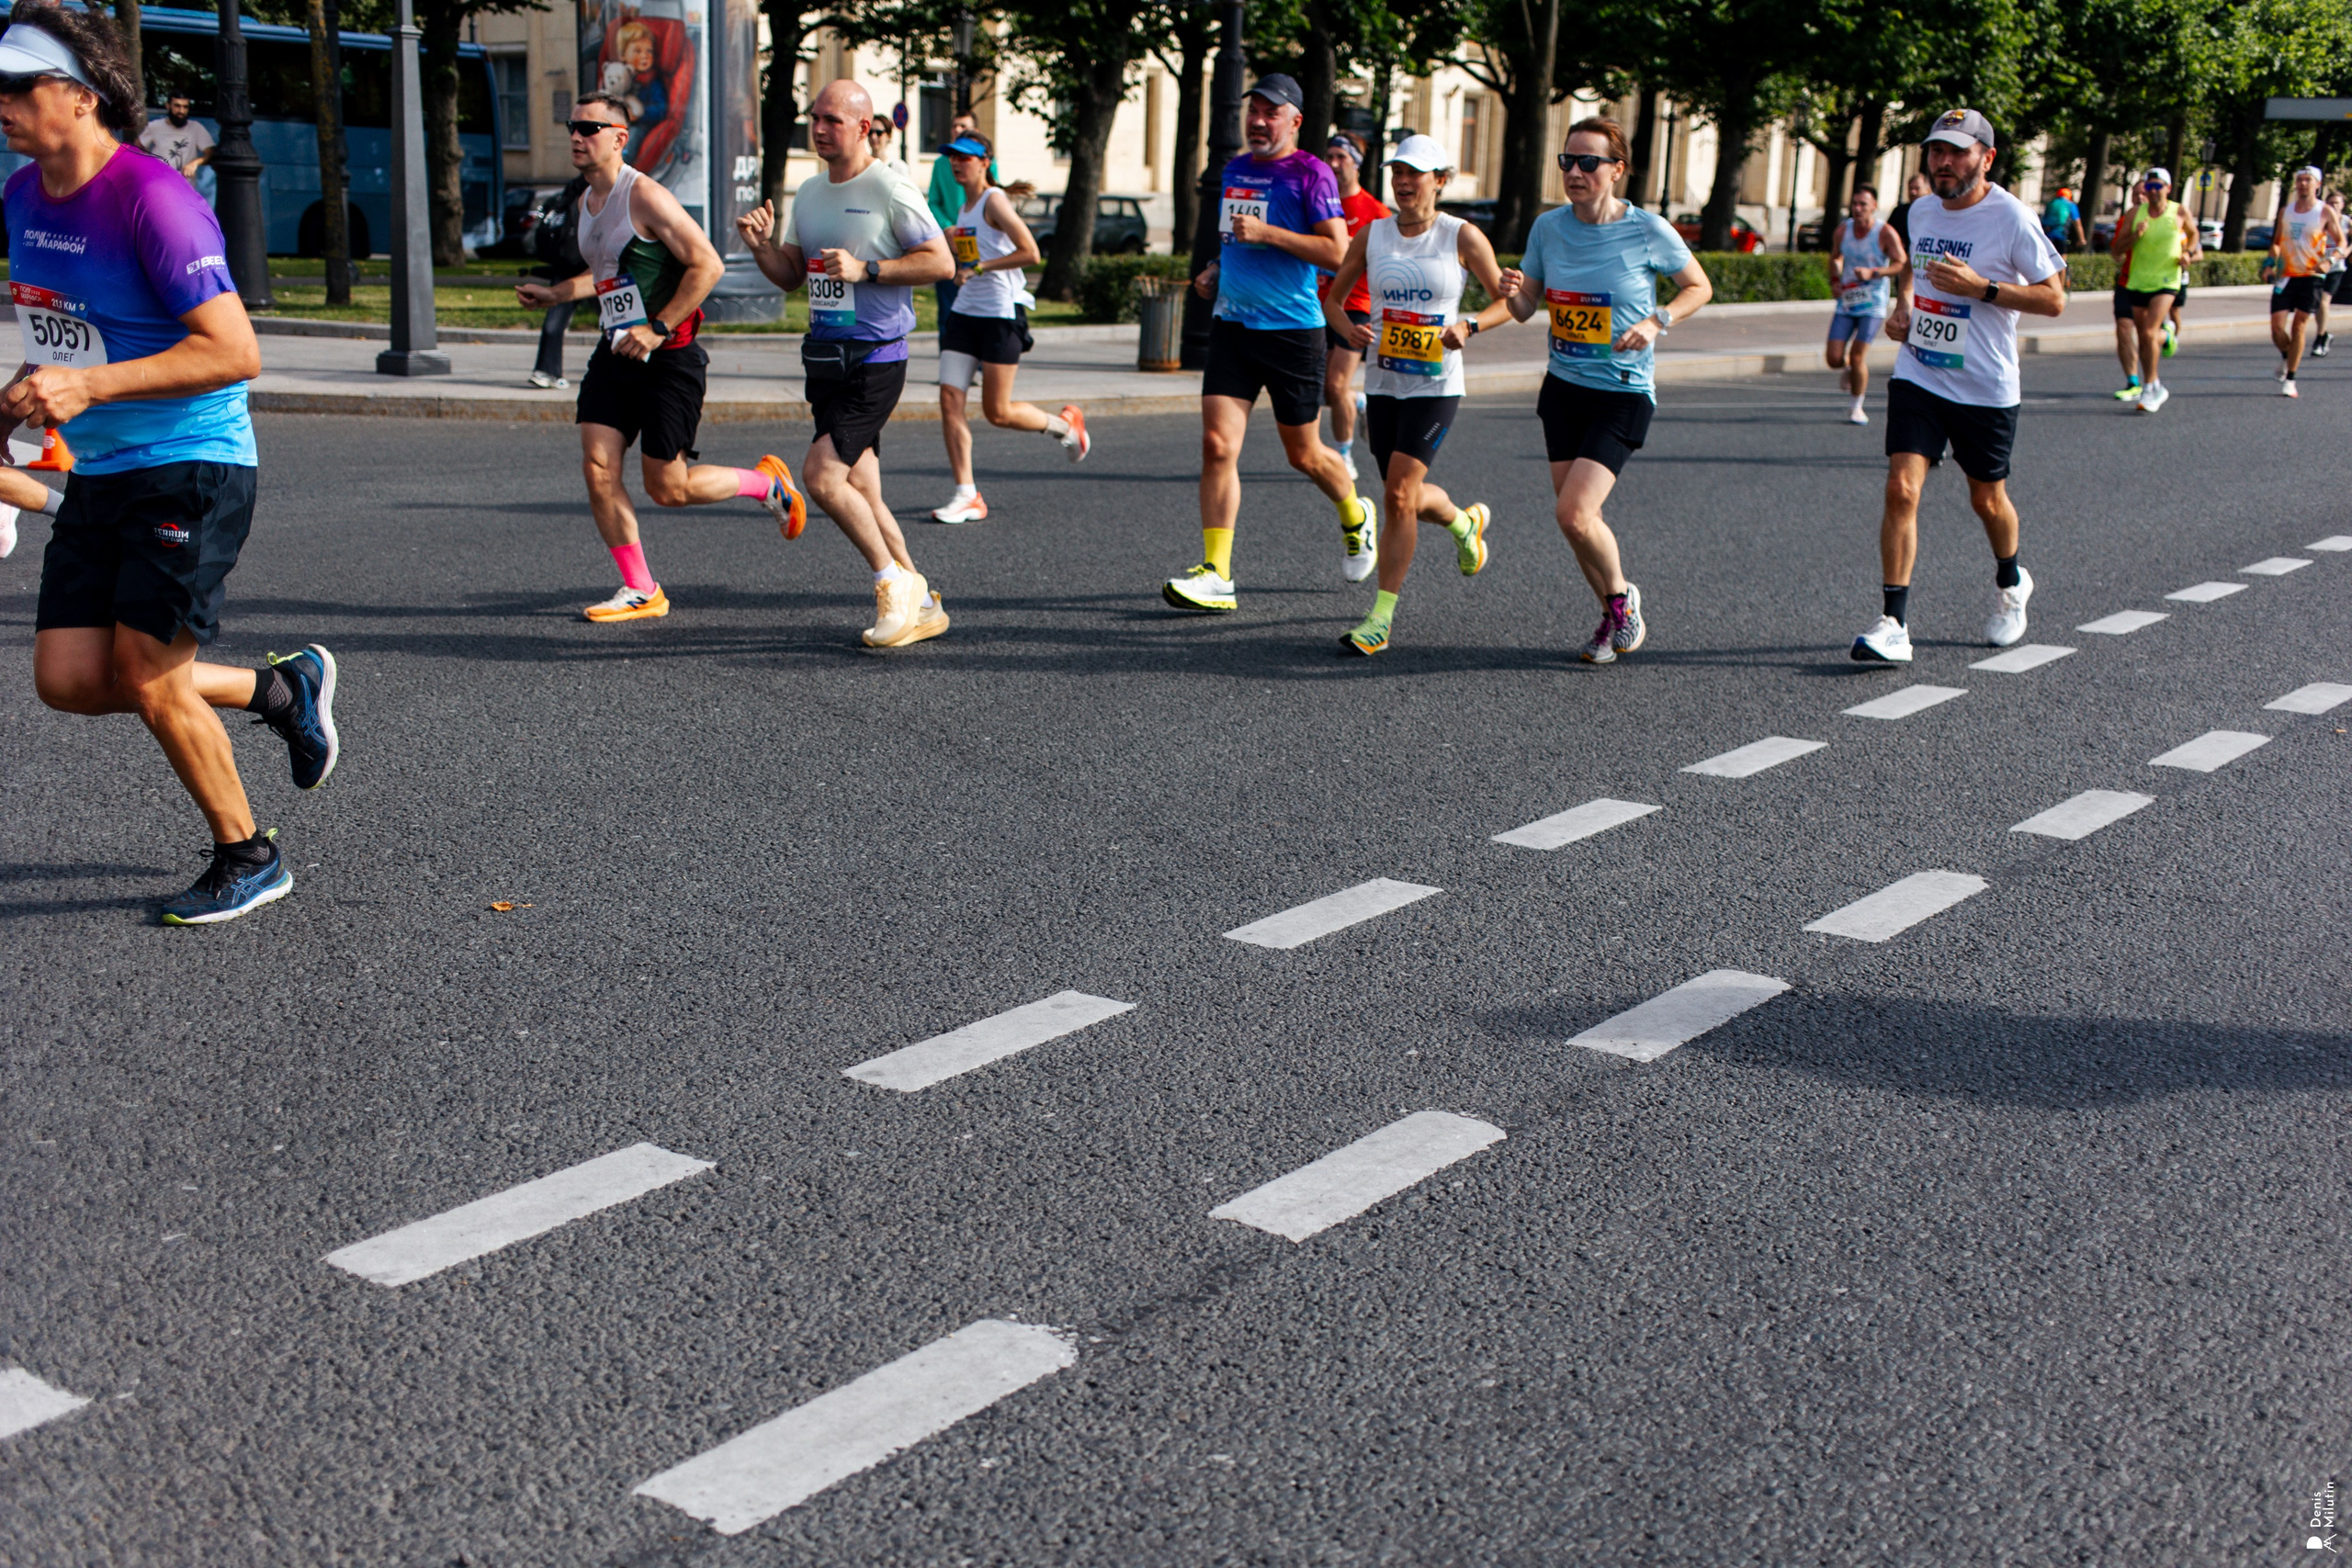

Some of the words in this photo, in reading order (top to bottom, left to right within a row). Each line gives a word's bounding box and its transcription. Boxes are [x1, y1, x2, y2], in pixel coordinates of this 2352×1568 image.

[40, 239, 85, 254] МАРАФОН
[1383, 288, 1433, 301] ИНГО
[1555, 309, 1602, 332] 6624
[1917, 315, 1957, 342] 6290
[28, 314, 90, 351] 5057
[1388, 326, 1434, 351] 5987
[52, 351, 74, 362] ОЛЕГ
